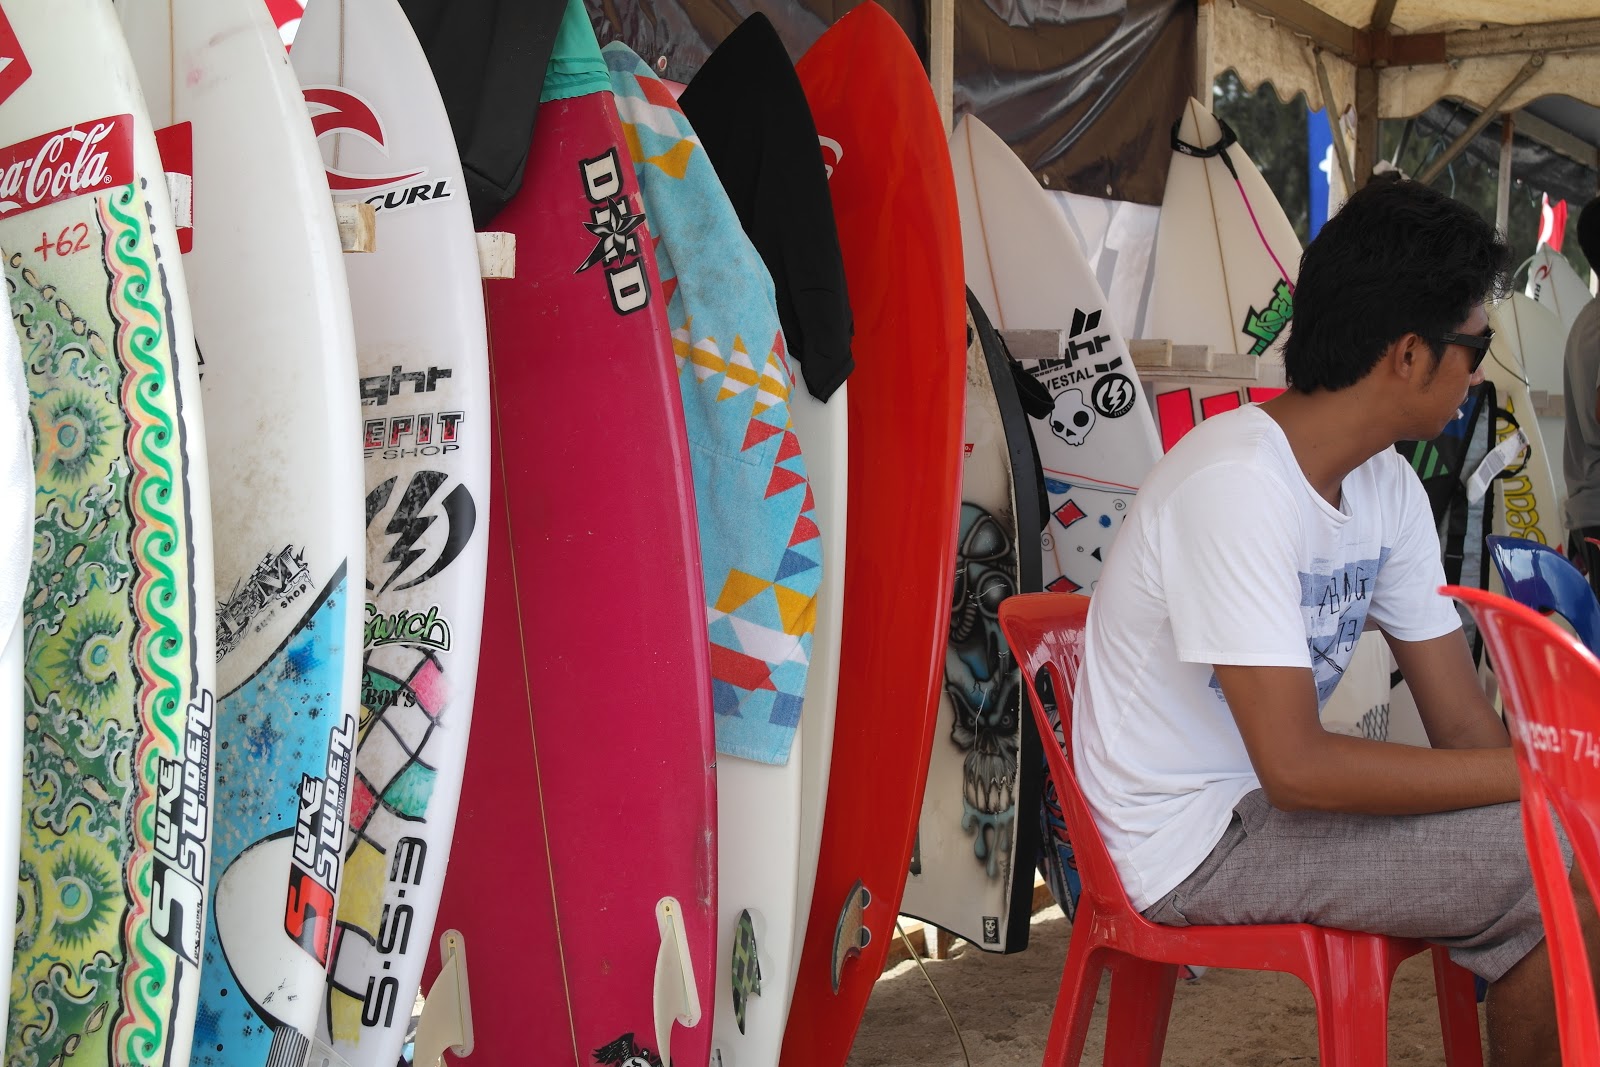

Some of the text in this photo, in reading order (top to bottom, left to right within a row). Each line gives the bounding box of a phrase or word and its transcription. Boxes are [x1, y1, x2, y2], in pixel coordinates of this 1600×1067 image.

[0, 121, 115, 205] a-Cola
[364, 180, 452, 212] CURL
[34, 222, 91, 262] +62
[1042, 367, 1094, 392] VESTAL
[382, 445, 460, 460] SHOP
[178, 688, 213, 887] STUDER
[199, 730, 209, 802] DIMENSIONS
[337, 751, 350, 818] DIMENSIONS
[154, 755, 183, 861] LUKE
[293, 772, 324, 869] LUKE
[314, 714, 356, 893] STUDER
